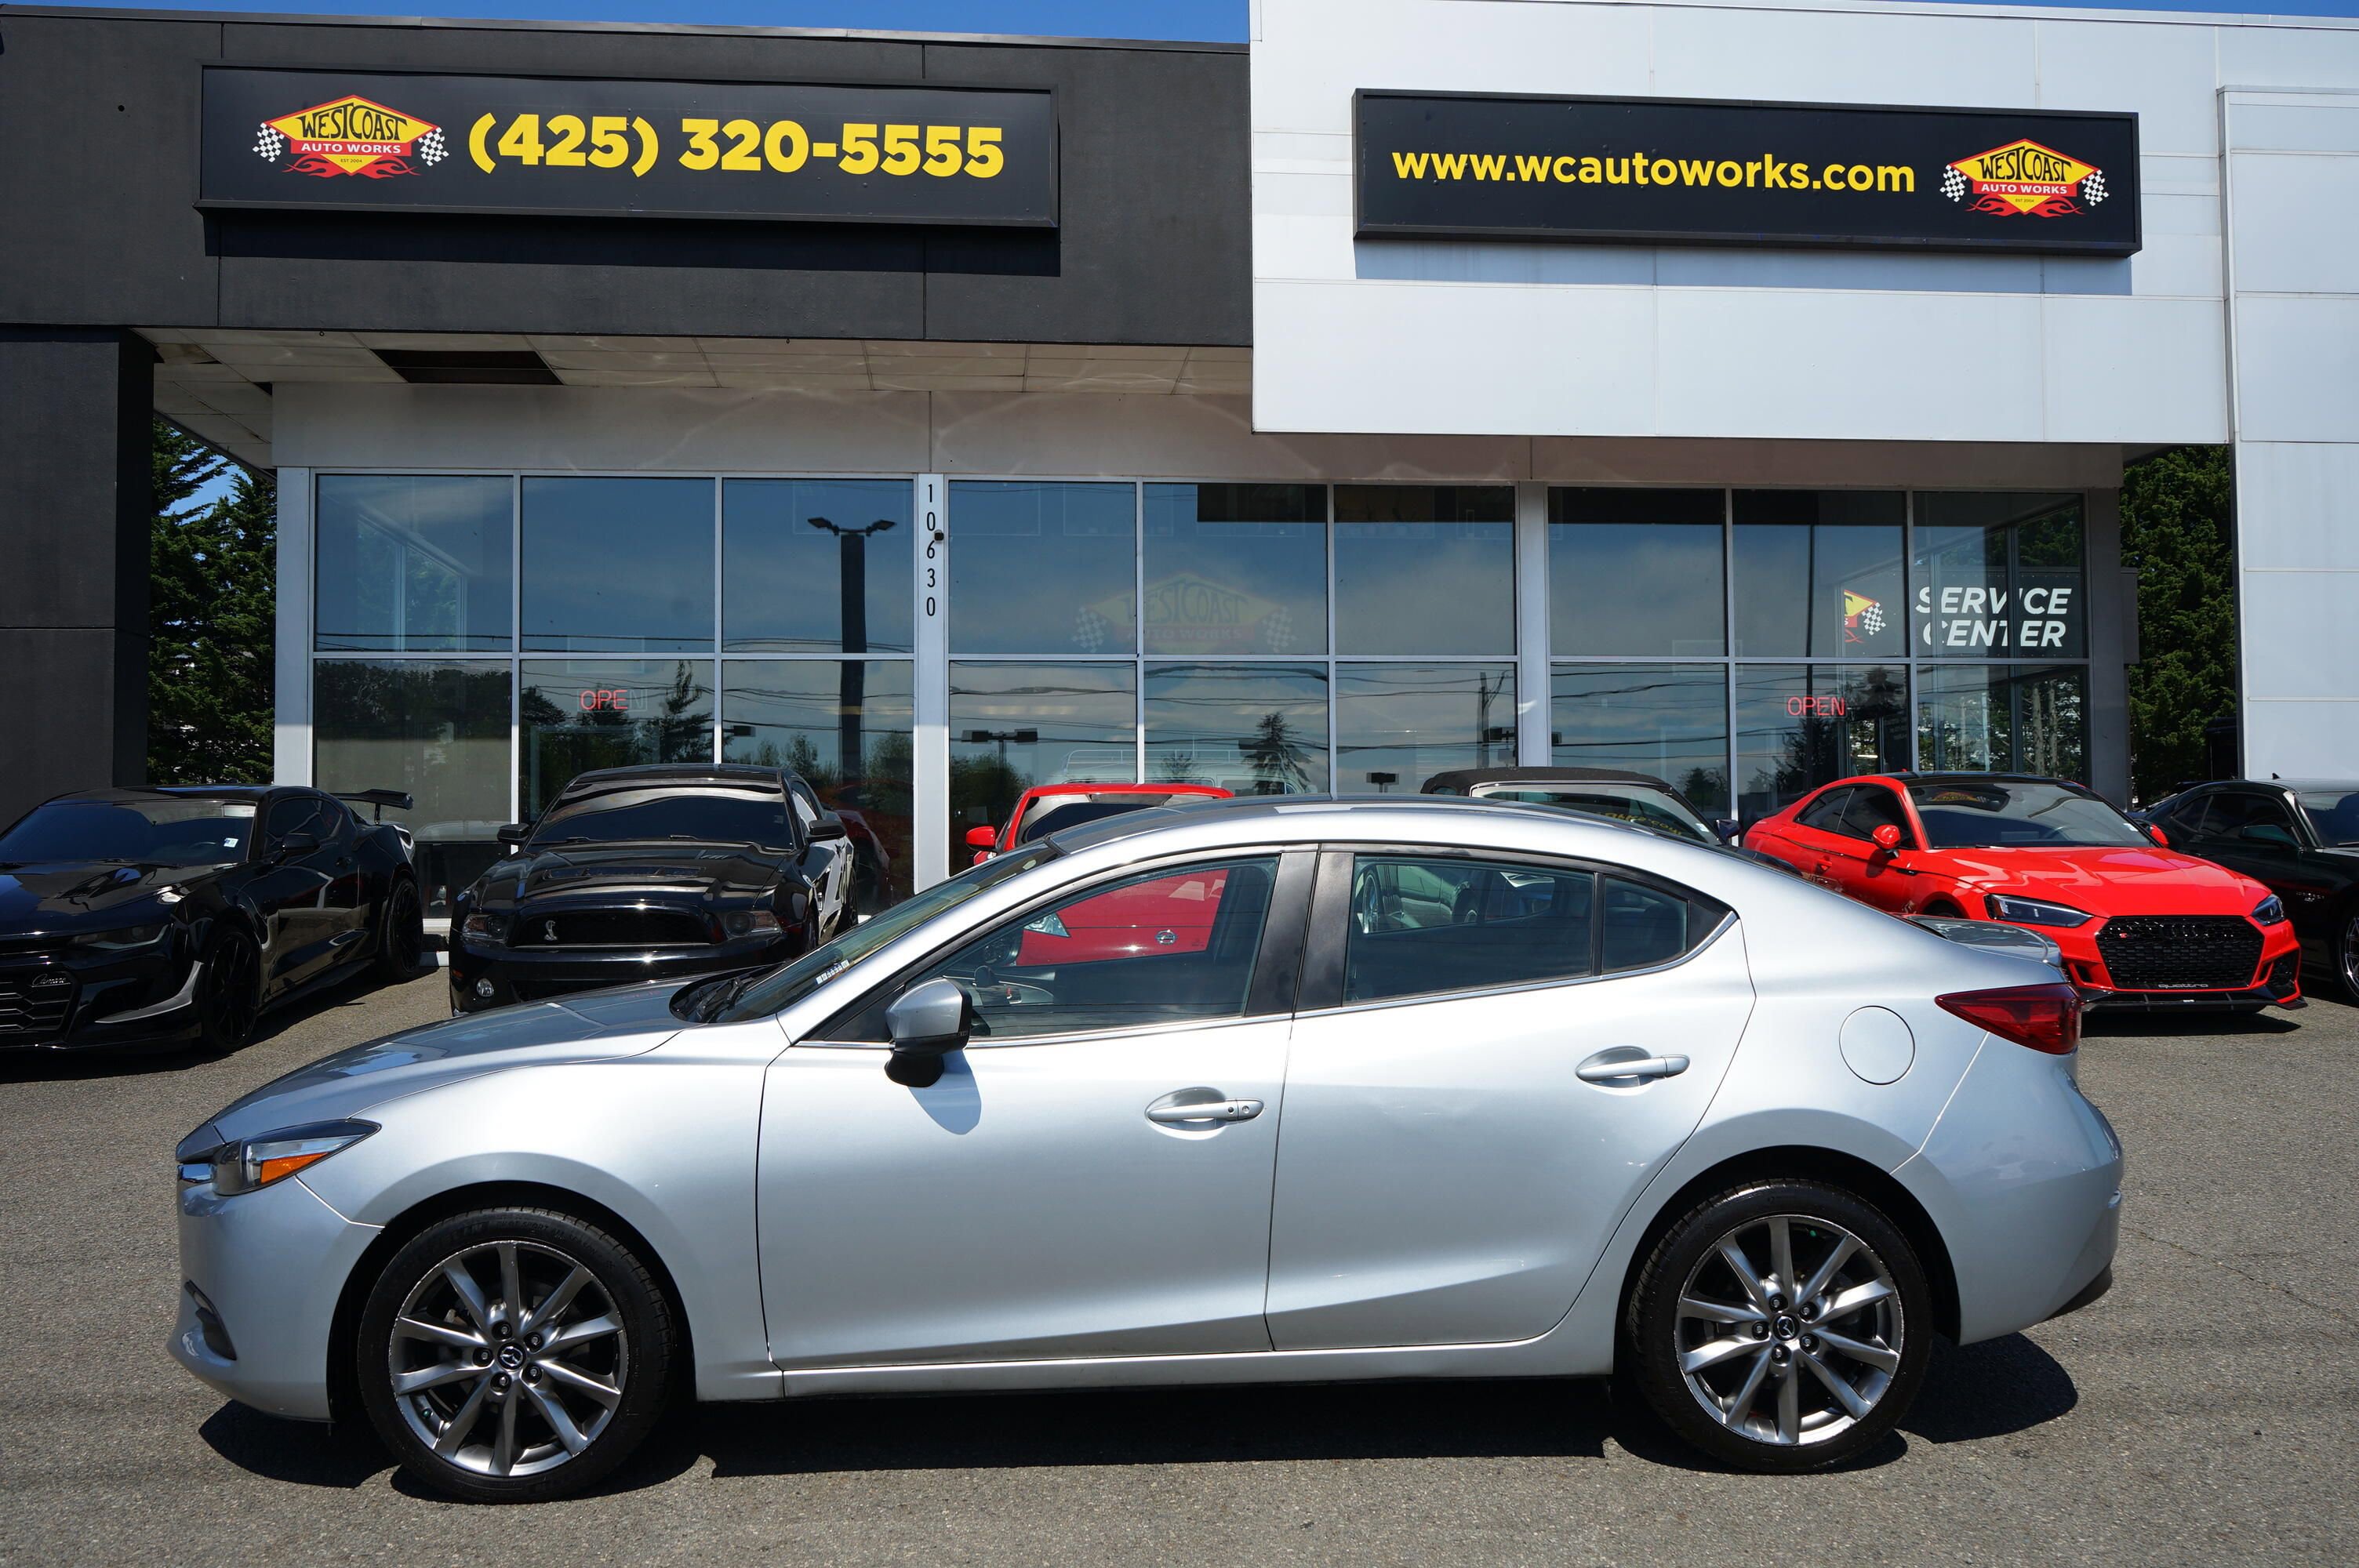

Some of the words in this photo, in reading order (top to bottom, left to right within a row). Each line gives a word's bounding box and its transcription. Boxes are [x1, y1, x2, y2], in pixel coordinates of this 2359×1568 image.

[301, 143, 343, 152] AUTO
[347, 143, 401, 154] WORKS
[468, 112, 659, 177] (425)
[678, 118, 1004, 178] 320-5555
[1392, 152, 1914, 192] www.wcautoworks.com
[1981, 183, 2017, 193] AUTO
[2020, 185, 2067, 194] WORKS
[926, 484, 936, 617] 10630
[1915, 586, 2072, 614] SERVCE
[1787, 695, 1845, 717] OPEN
